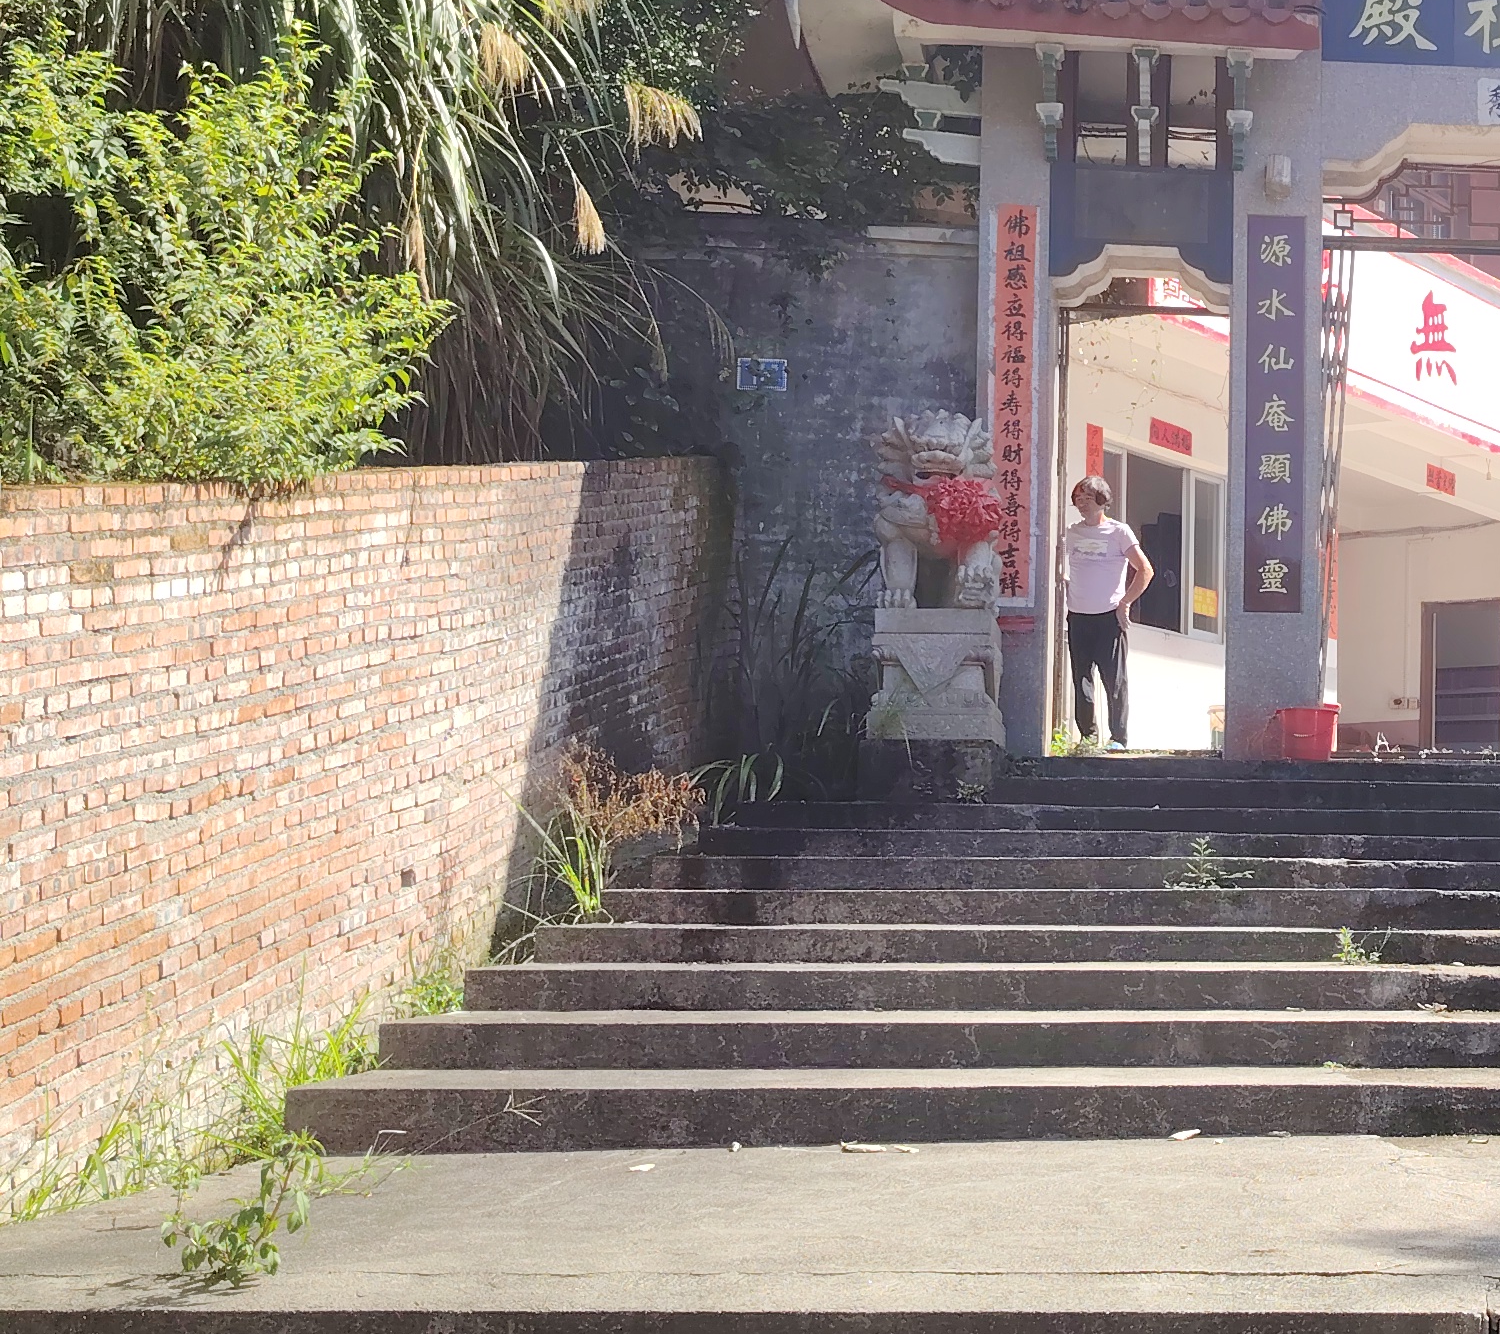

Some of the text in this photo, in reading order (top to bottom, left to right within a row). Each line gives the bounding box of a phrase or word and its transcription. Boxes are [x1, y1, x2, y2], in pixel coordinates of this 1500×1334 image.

[1256, 234, 1296, 594] 源水仙庵顯佛靈
